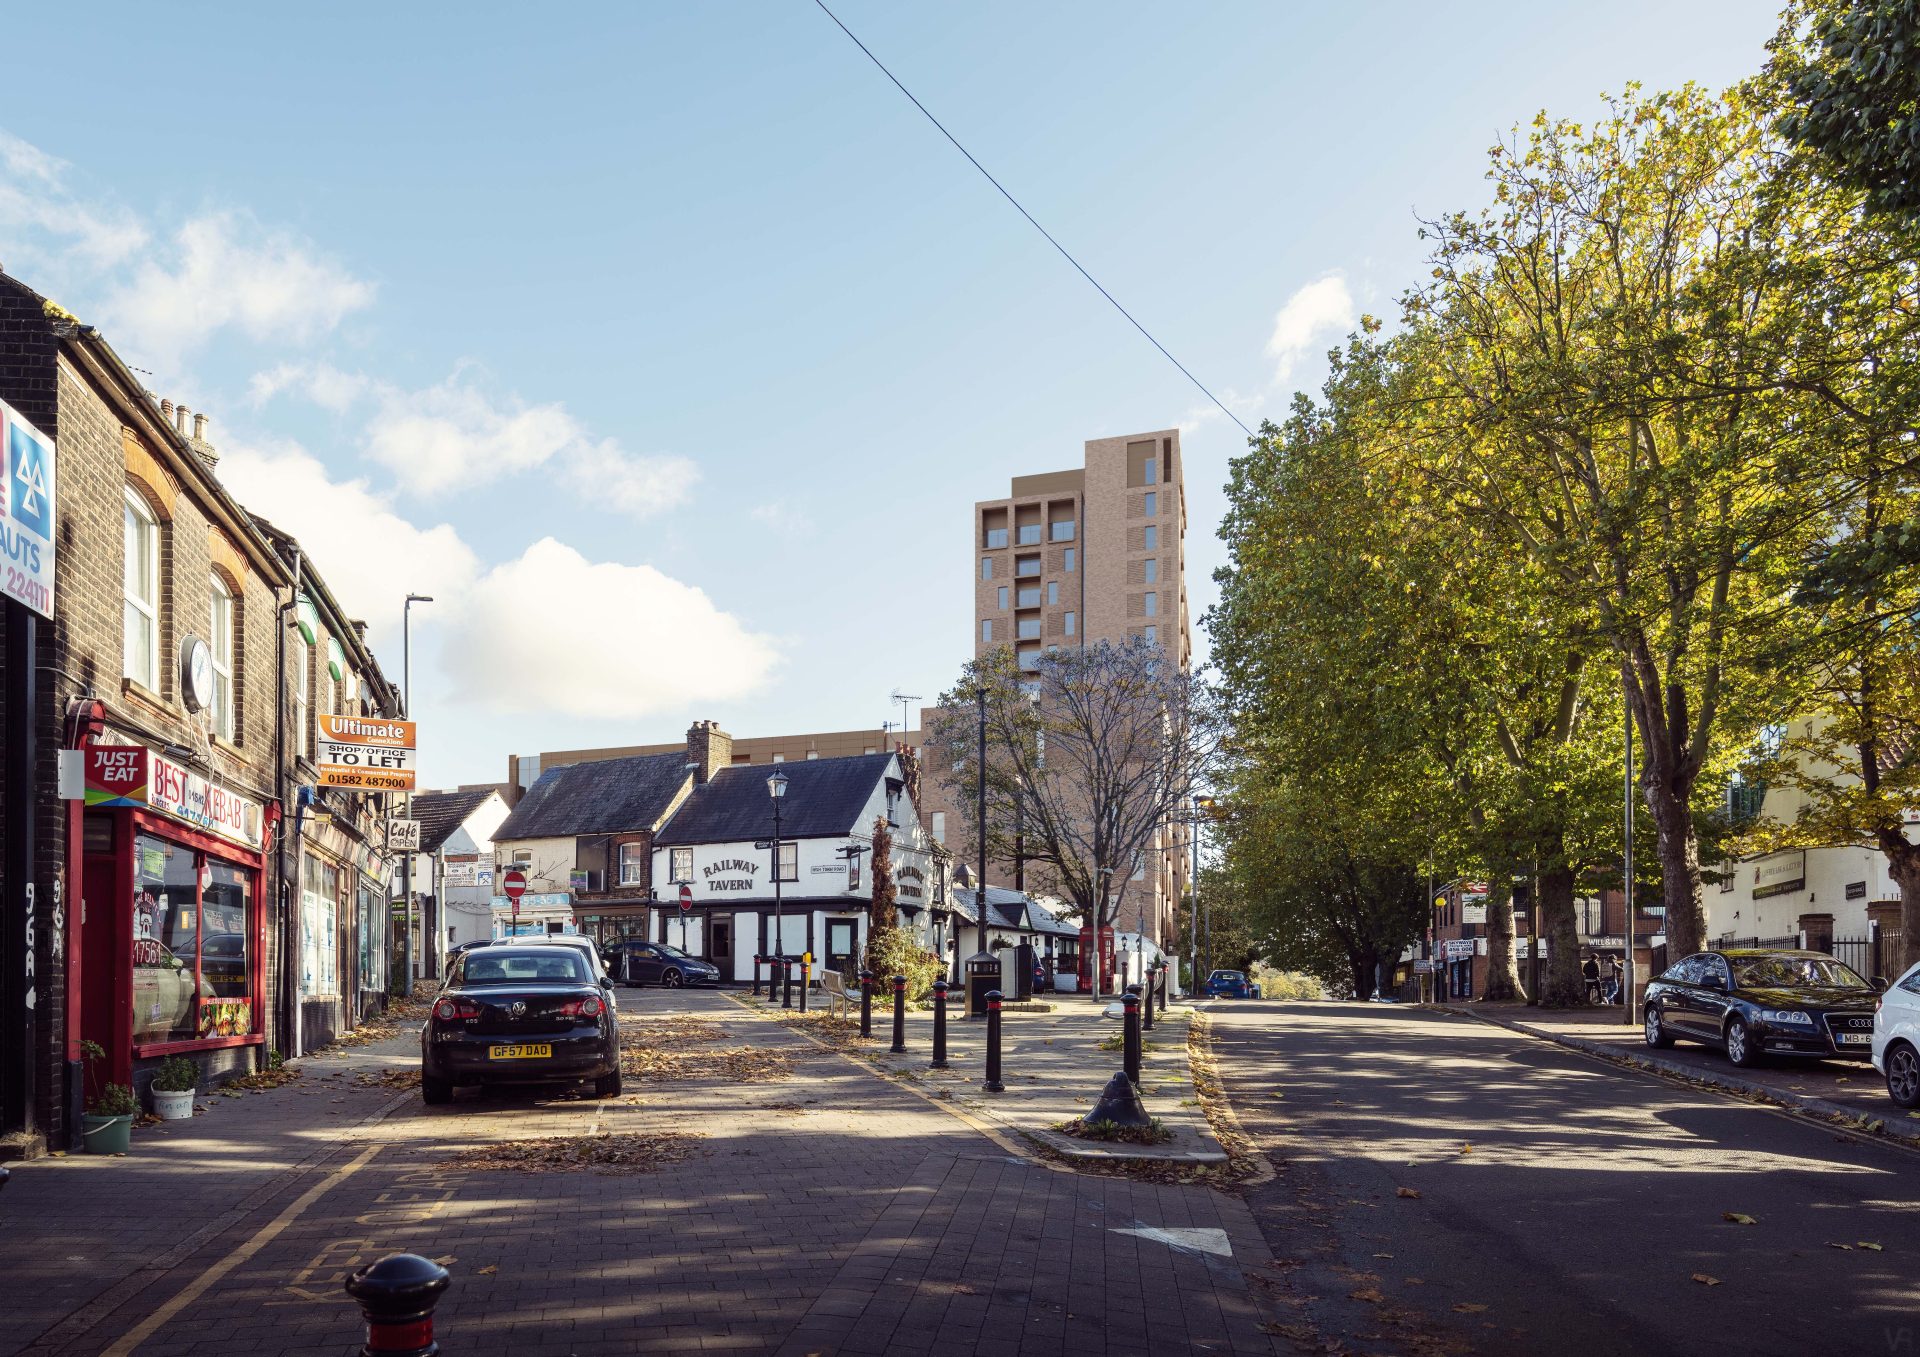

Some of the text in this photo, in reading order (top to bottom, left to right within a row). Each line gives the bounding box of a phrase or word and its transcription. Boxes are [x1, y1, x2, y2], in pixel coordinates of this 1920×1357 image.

[6, 566, 50, 613] 224111
[331, 717, 405, 739] Ultimate
[94, 751, 138, 768] JUST
[328, 752, 406, 768] TO LET
[103, 767, 138, 782] EAT
[328, 774, 406, 788] 01582 487900
[390, 771, 414, 779] Property
[155, 758, 241, 830] BEST KEBAB
[391, 822, 416, 840] Café
[703, 859, 759, 878] RAILWAY
[897, 866, 924, 884] RAILWAY
[708, 879, 753, 891] TAVERN
[899, 885, 922, 897] TAVERN
[1588, 938, 1605, 946] WILL
[132, 941, 161, 965] 17561
[494, 1045, 547, 1057] GF57 DAO
